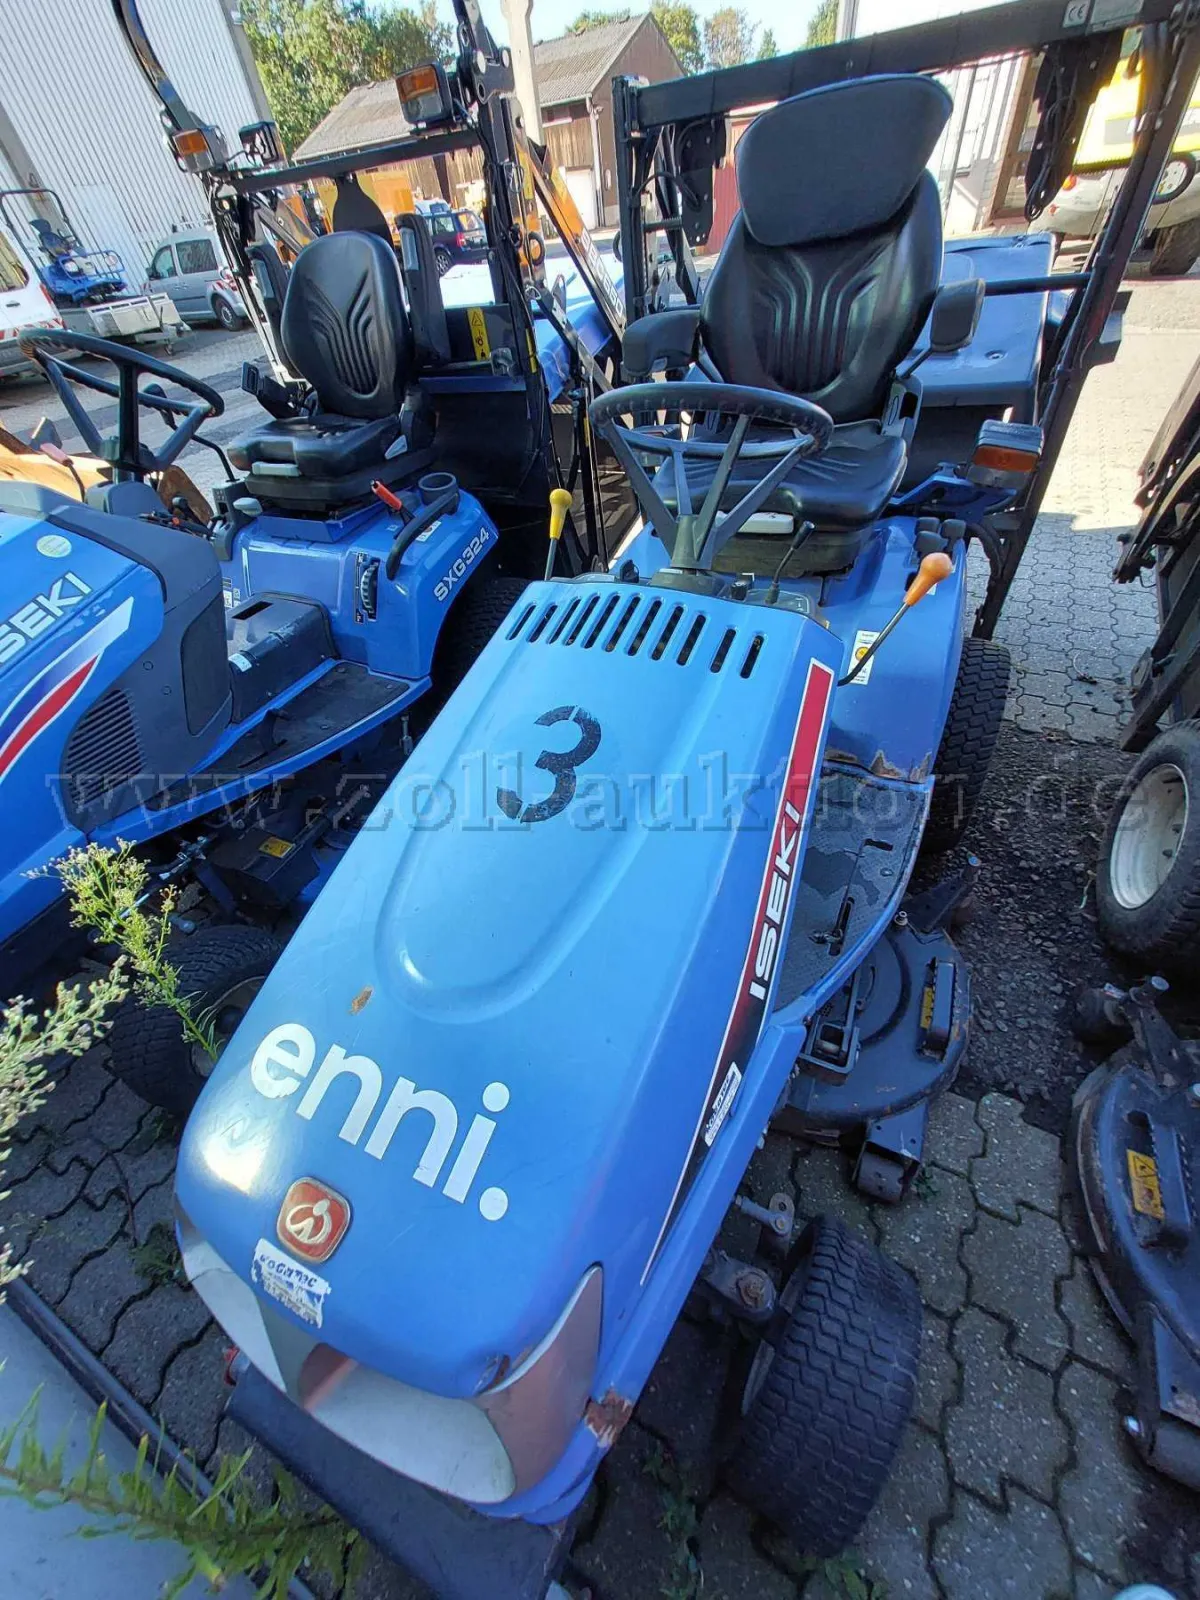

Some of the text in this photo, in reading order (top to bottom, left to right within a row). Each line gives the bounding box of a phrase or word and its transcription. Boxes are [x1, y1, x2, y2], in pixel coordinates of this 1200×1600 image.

[433, 527, 489, 602] SXG324
[494, 705, 602, 824] 3
[749, 801, 801, 1001] ISEKI
[251, 1022, 510, 1222] enni.
